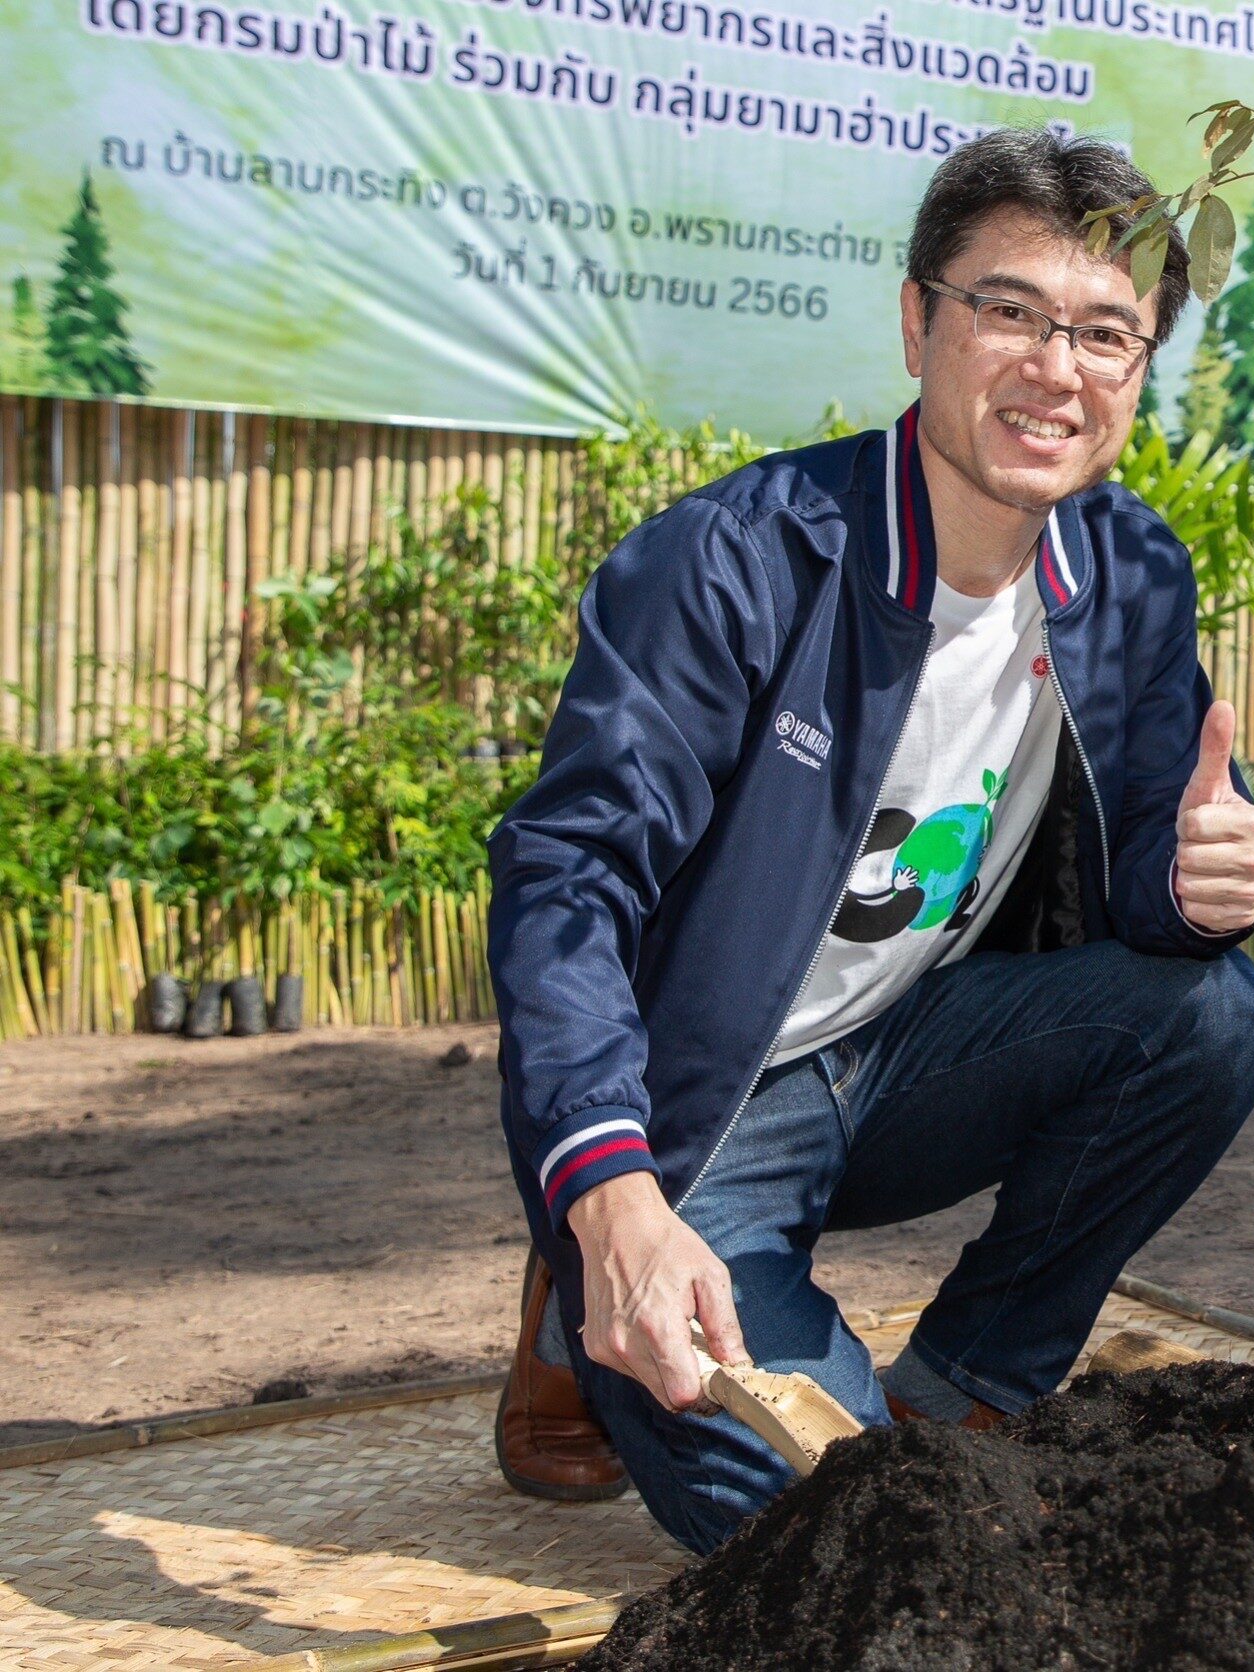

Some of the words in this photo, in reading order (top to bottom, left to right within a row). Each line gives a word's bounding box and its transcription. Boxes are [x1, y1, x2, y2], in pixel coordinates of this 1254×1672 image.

[452, 33, 615, 105] ร่วมกับ
[101, 136, 146, 171] ณ
[630, 206, 882, 266] อ.พรานกระต่าย
[452, 237, 527, 284] วันที่
[540, 253, 558, 292] 1
[728, 275, 828, 321] 2566
[792, 719, 832, 760] YAMAHA
